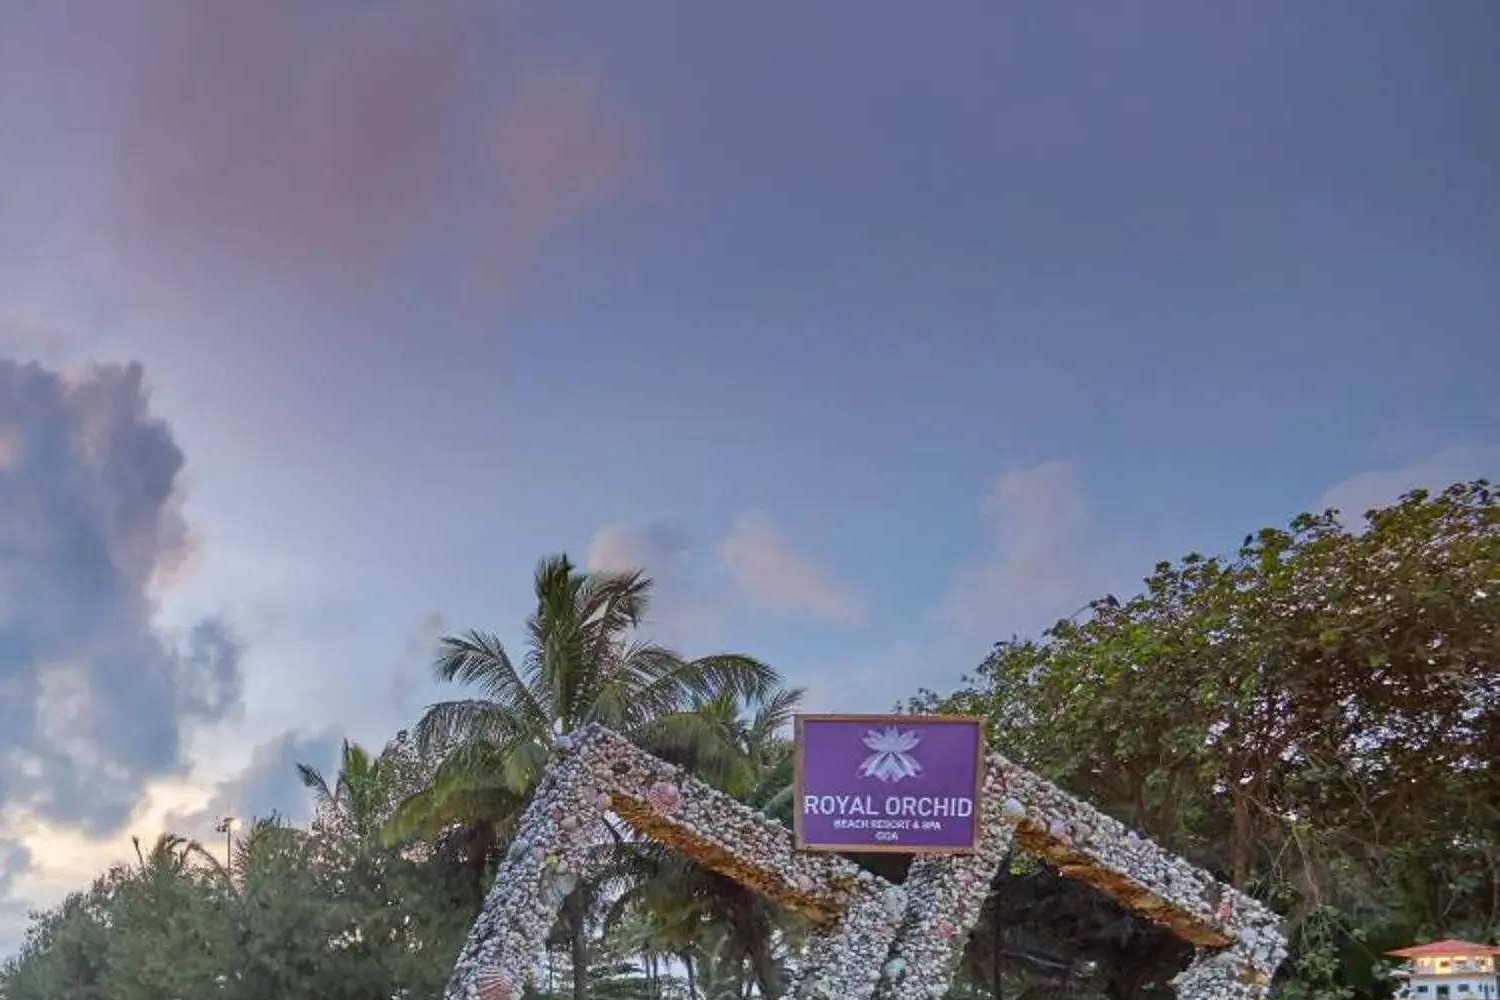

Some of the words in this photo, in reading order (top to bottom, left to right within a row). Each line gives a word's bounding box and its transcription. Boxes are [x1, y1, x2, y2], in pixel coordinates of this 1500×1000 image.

[804, 795, 879, 815] ROYAL
[885, 796, 973, 817] ORCHID
[833, 819, 869, 829] BEACH
[871, 819, 910, 830] RESORT
[875, 831, 899, 841] GOA
